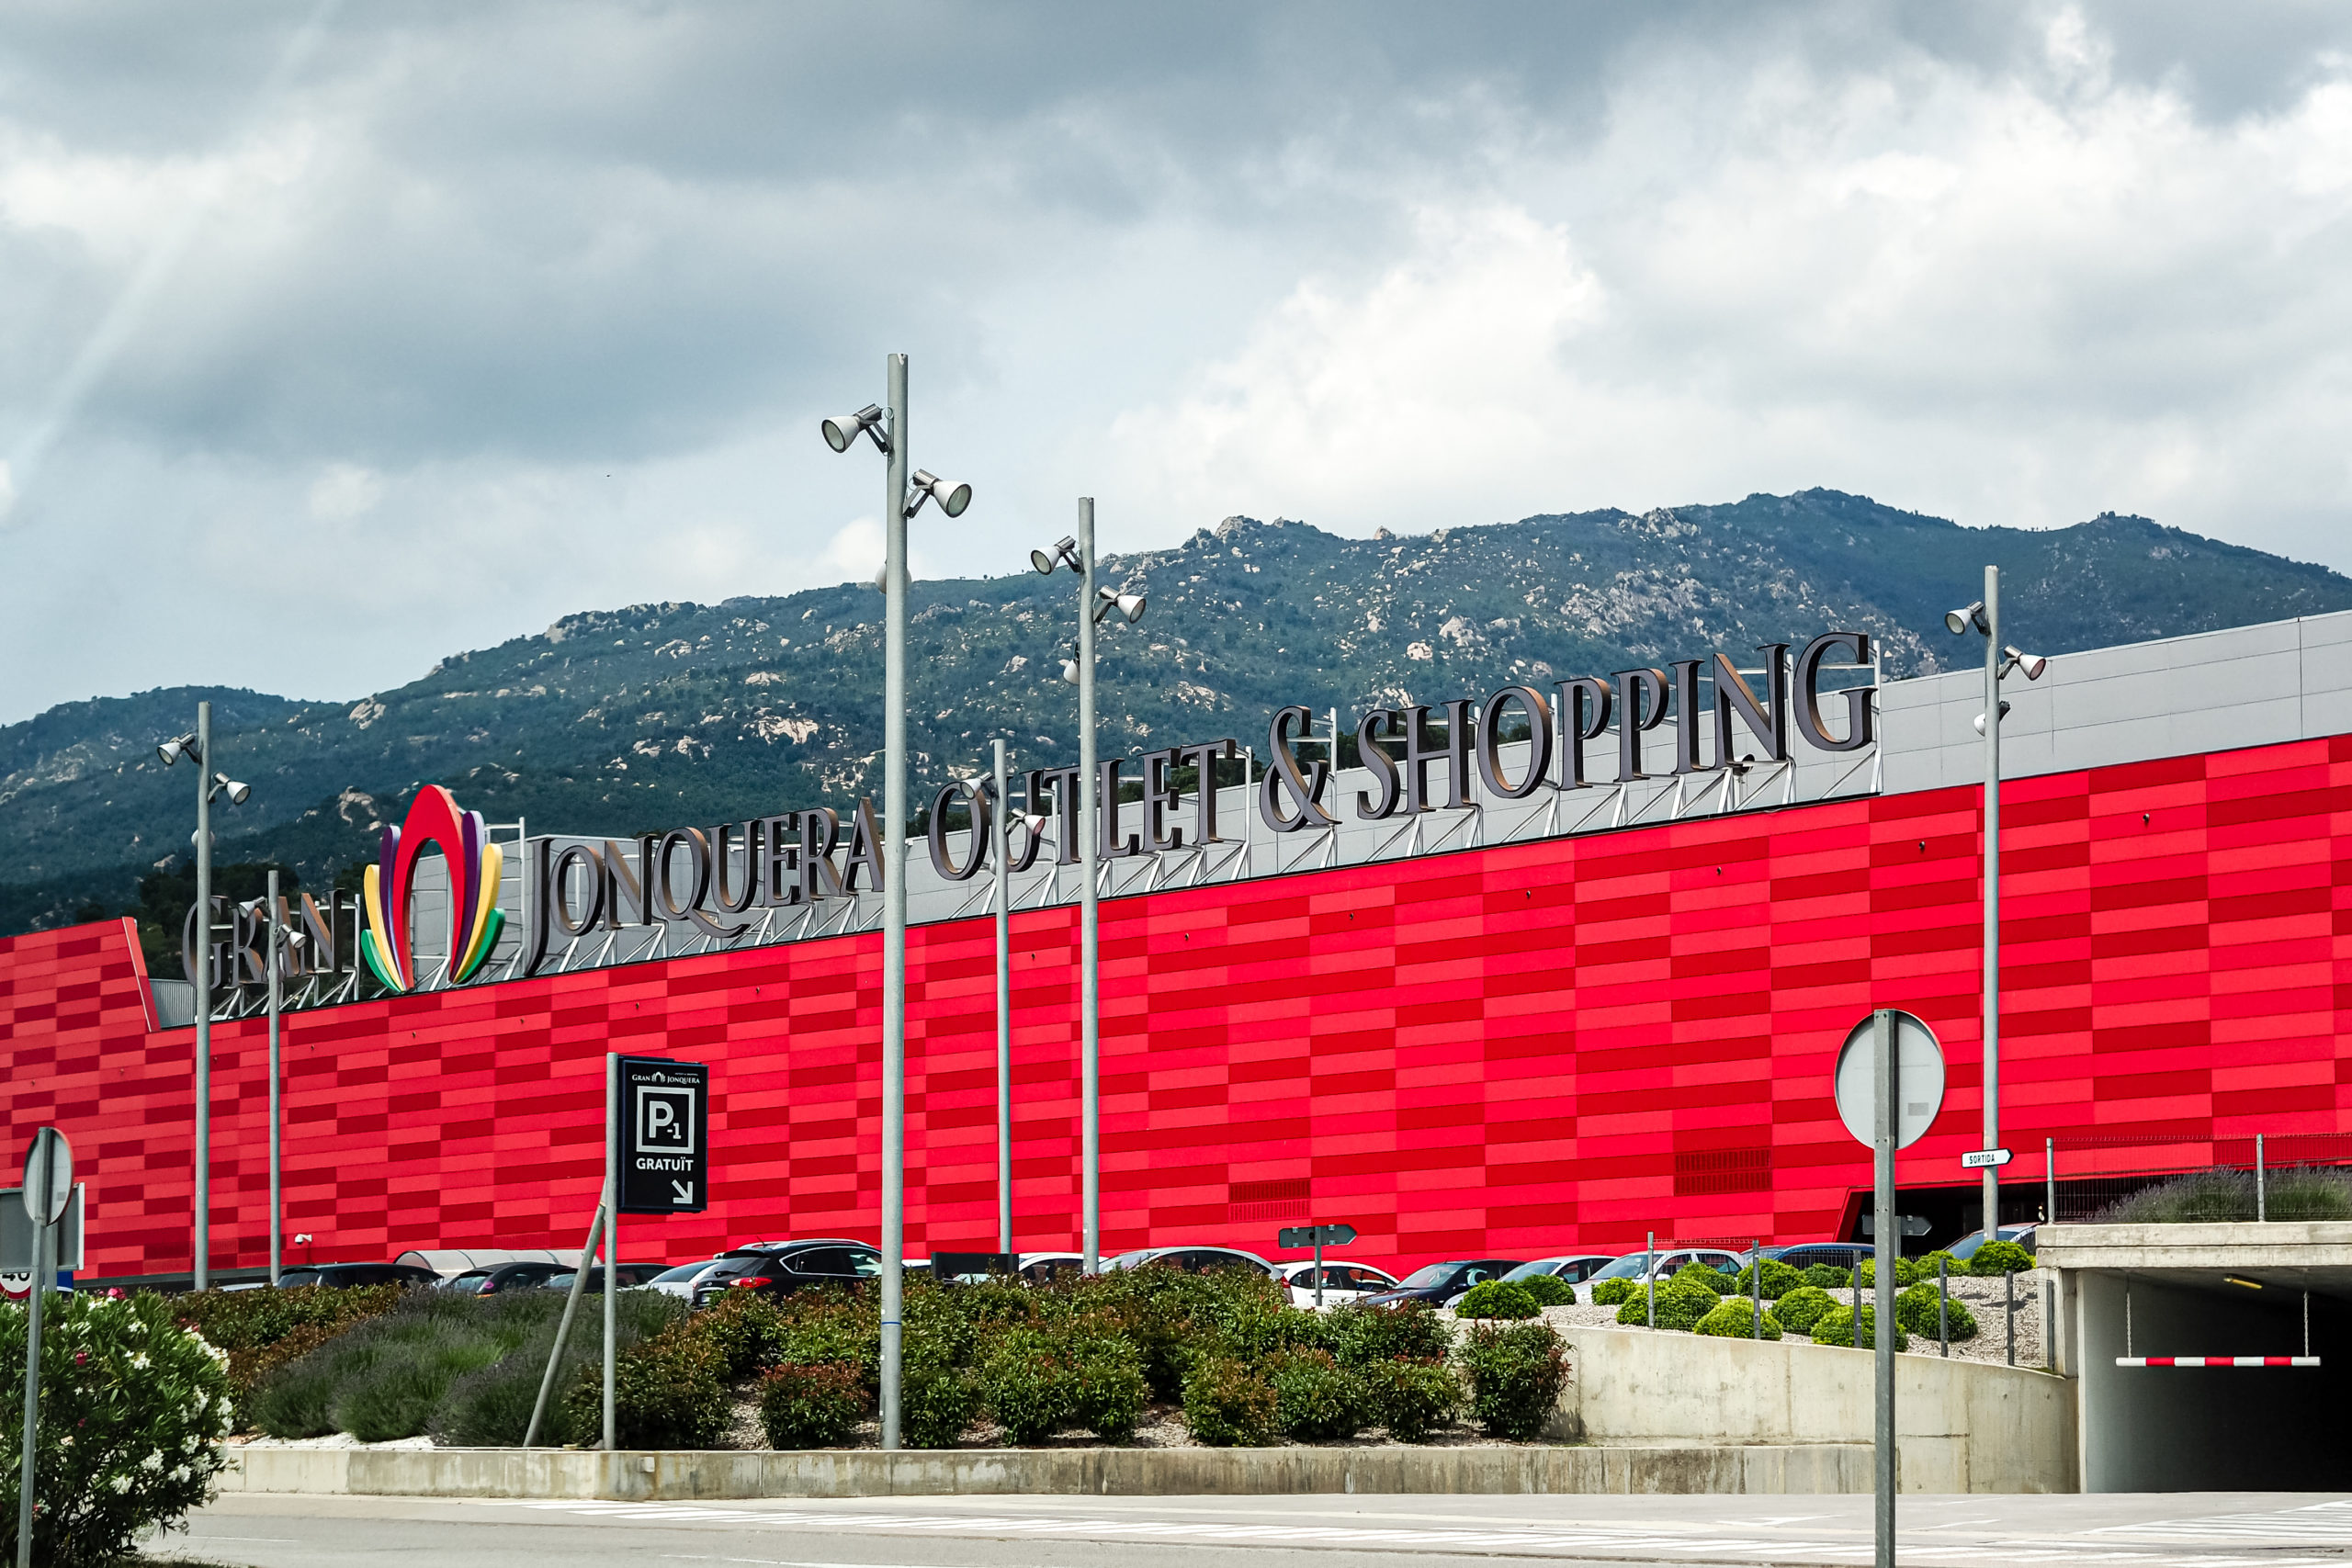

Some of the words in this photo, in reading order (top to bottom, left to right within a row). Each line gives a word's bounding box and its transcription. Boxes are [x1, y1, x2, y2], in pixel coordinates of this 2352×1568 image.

[525, 795, 886, 977] JONQUERA
[928, 739, 1236, 881] OUTLET
[1259, 705, 1342, 833] &
[1357, 632, 1872, 820] SHOPPING
[667, 1076, 700, 1084] JONQUERA
[636, 1156, 694, 1171] GRATUÏT
[1969, 1154, 1996, 1164] SORTIDA
